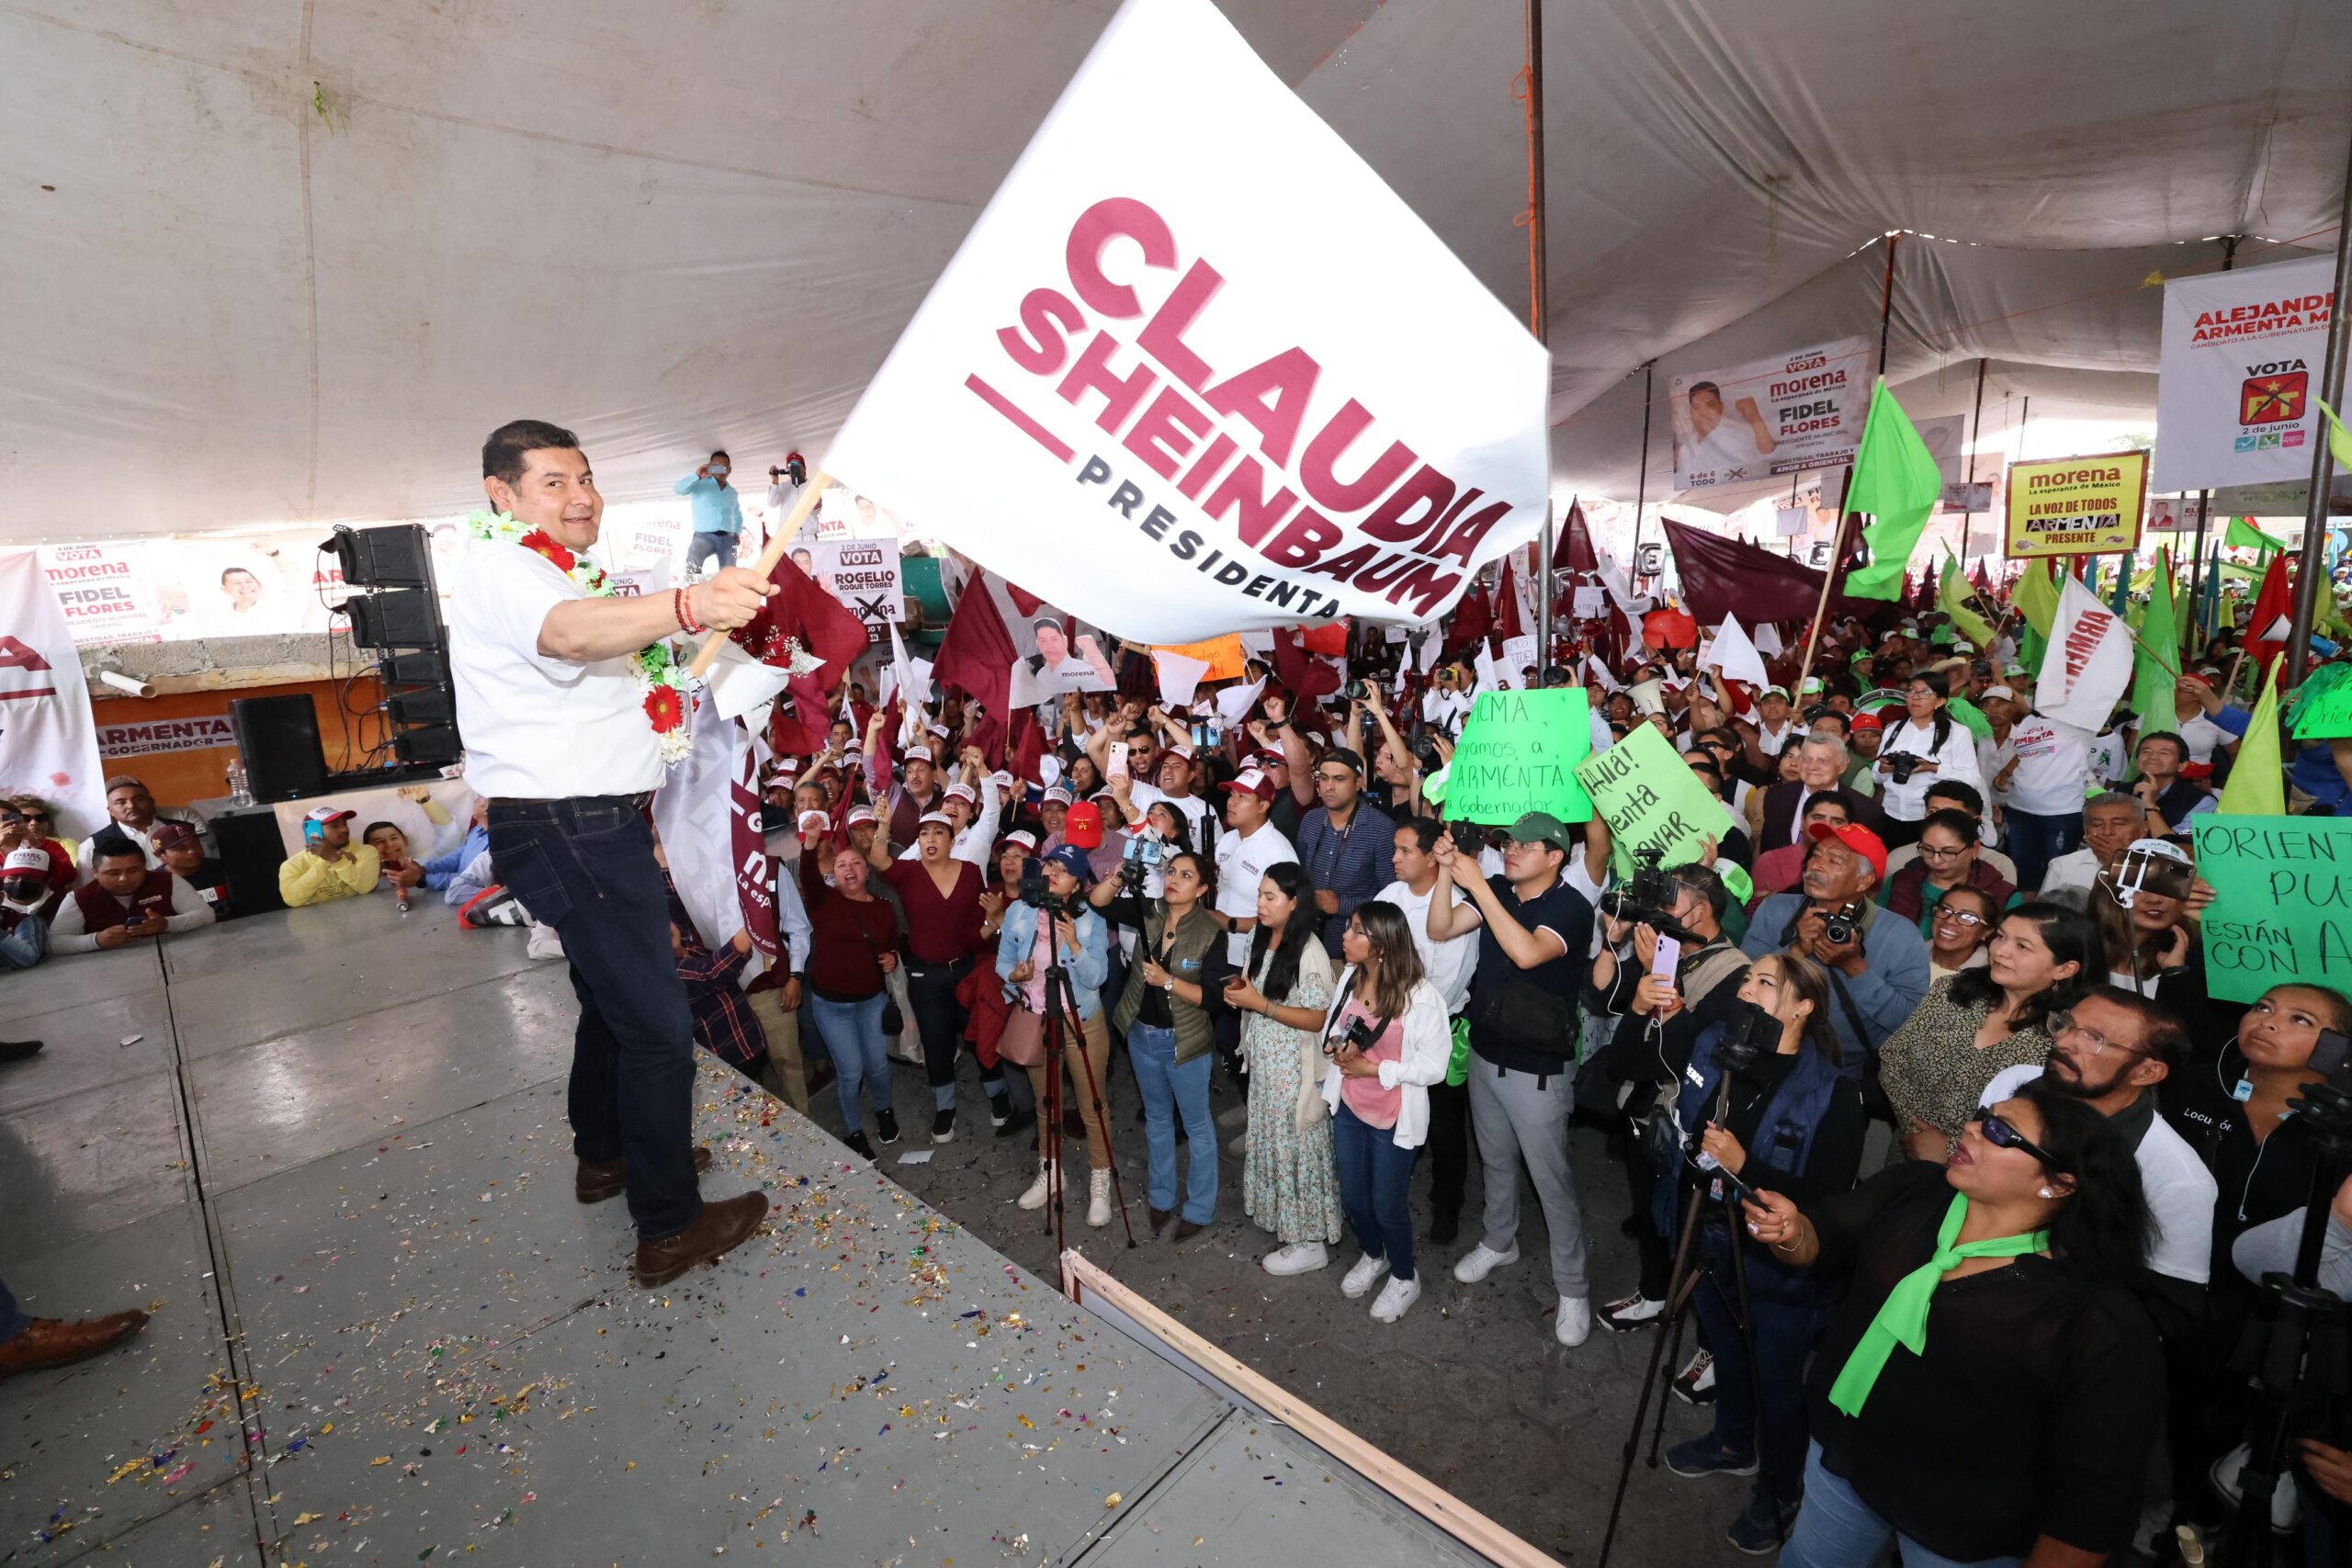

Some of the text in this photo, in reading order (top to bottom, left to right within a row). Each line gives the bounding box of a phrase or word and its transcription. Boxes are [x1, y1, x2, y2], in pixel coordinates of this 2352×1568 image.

[2192, 310, 2333, 342] ARMENTA M
[2190, 338, 2238, 349] CANDIDATO
[2258, 324, 2320, 340] GUBERNATURA
[1804, 350, 1823, 358] JUNIO
[1788, 357, 1824, 372] VOTA
[2246, 358, 2307, 377] VOTA
[1066, 197, 1514, 568] CLAUDIA
[1770, 369, 1847, 397] morena
[1780, 391, 1814, 401] esperanza
[1780, 399, 1839, 423] FIDEL
[2247, 391, 2299, 421] PT
[1781, 415, 1840, 436] FLORES
[2252, 425, 2267, 434] de
[2269, 422, 2300, 433] junio
[1813, 429, 1849, 439] MUNICIPAL
[996, 287, 1464, 618] SHEINBAUM
[1795, 441, 1826, 449] ORIENTAL
[1815, 448, 1849, 458] TRABAJO
[1776, 463, 1800, 473] AMOR
[1808, 457, 1849, 468] ORIENTAL
[1690, 478, 1715, 487] TODO
[2030, 467, 2121, 488] morena
[2040, 485, 2077, 494] esperanza
[2030, 497, 2117, 515] LA VOZ DE TODOS
[2027, 514, 2118, 532] ARMENTA
[635, 532, 673, 547] FIDEL
[1076, 454, 1340, 619] PRESIDENTA
[2045, 532, 2096, 544] PRESENTE
[58, 549, 98, 561] VOTA
[634, 544, 673, 557] FLORES
[841, 551, 882, 565] VOTA
[44, 561, 130, 581] morena
[835, 570, 895, 585] ROGELIO
[839, 582, 865, 591] ROQUE
[59, 587, 130, 604] FIDEL
[64, 601, 135, 617] FLORES
[847, 604, 896, 619] mona
[65, 617, 107, 626] RESIDENTE
[74, 633, 117, 643] NESTIDAD,
[118, 630, 153, 638] TRABAJO
[2014, 730, 2054, 747] RMENTA
[107, 739, 213, 755] GOBERNADOR
[1532, 741, 1543, 753] a
[1456, 764, 1564, 790] ARMENTA
[1459, 790, 1554, 815] Gobernador
[737, 873, 750, 891] La
[2205, 919, 2292, 947] ESTÁN
[2211, 942, 2299, 975] CON
